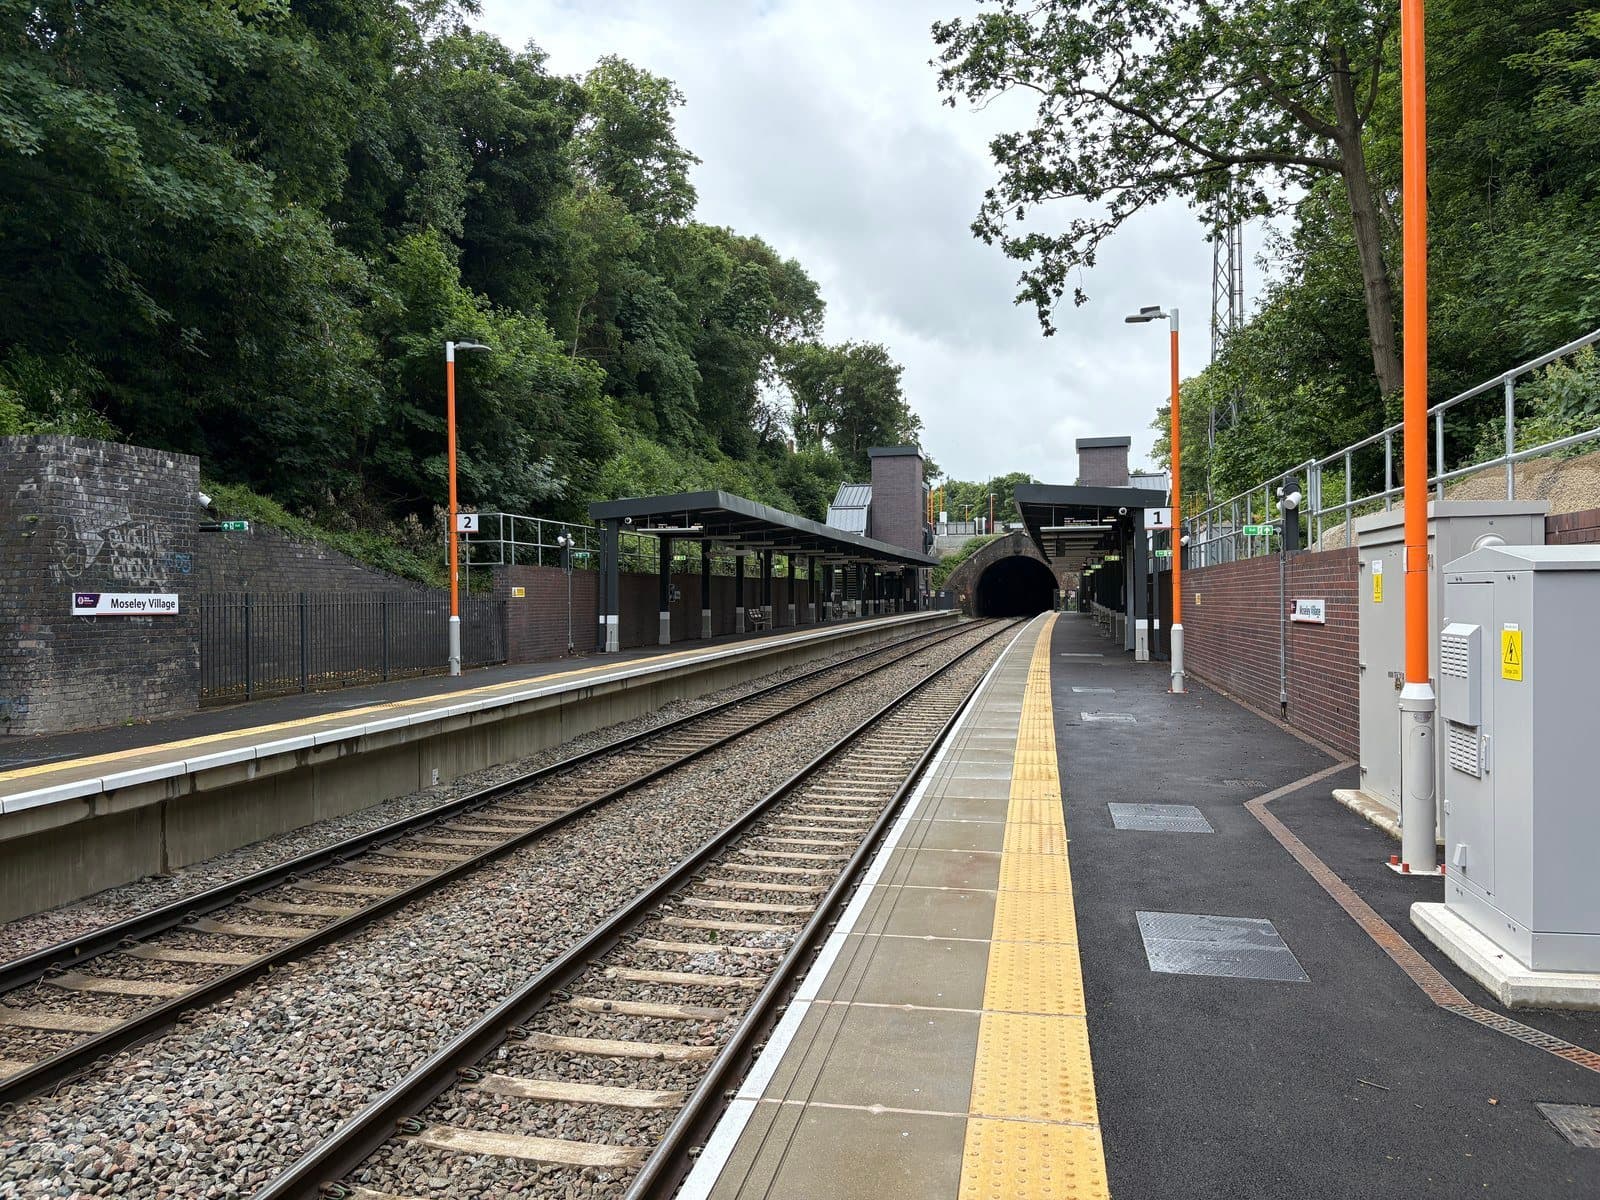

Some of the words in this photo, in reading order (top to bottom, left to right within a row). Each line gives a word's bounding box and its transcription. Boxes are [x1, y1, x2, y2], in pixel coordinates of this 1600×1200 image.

[464, 516, 472, 528] 2
[1153, 511, 1163, 524] 1
[110, 598, 146, 610] Moseley
[148, 598, 176, 610] Village
